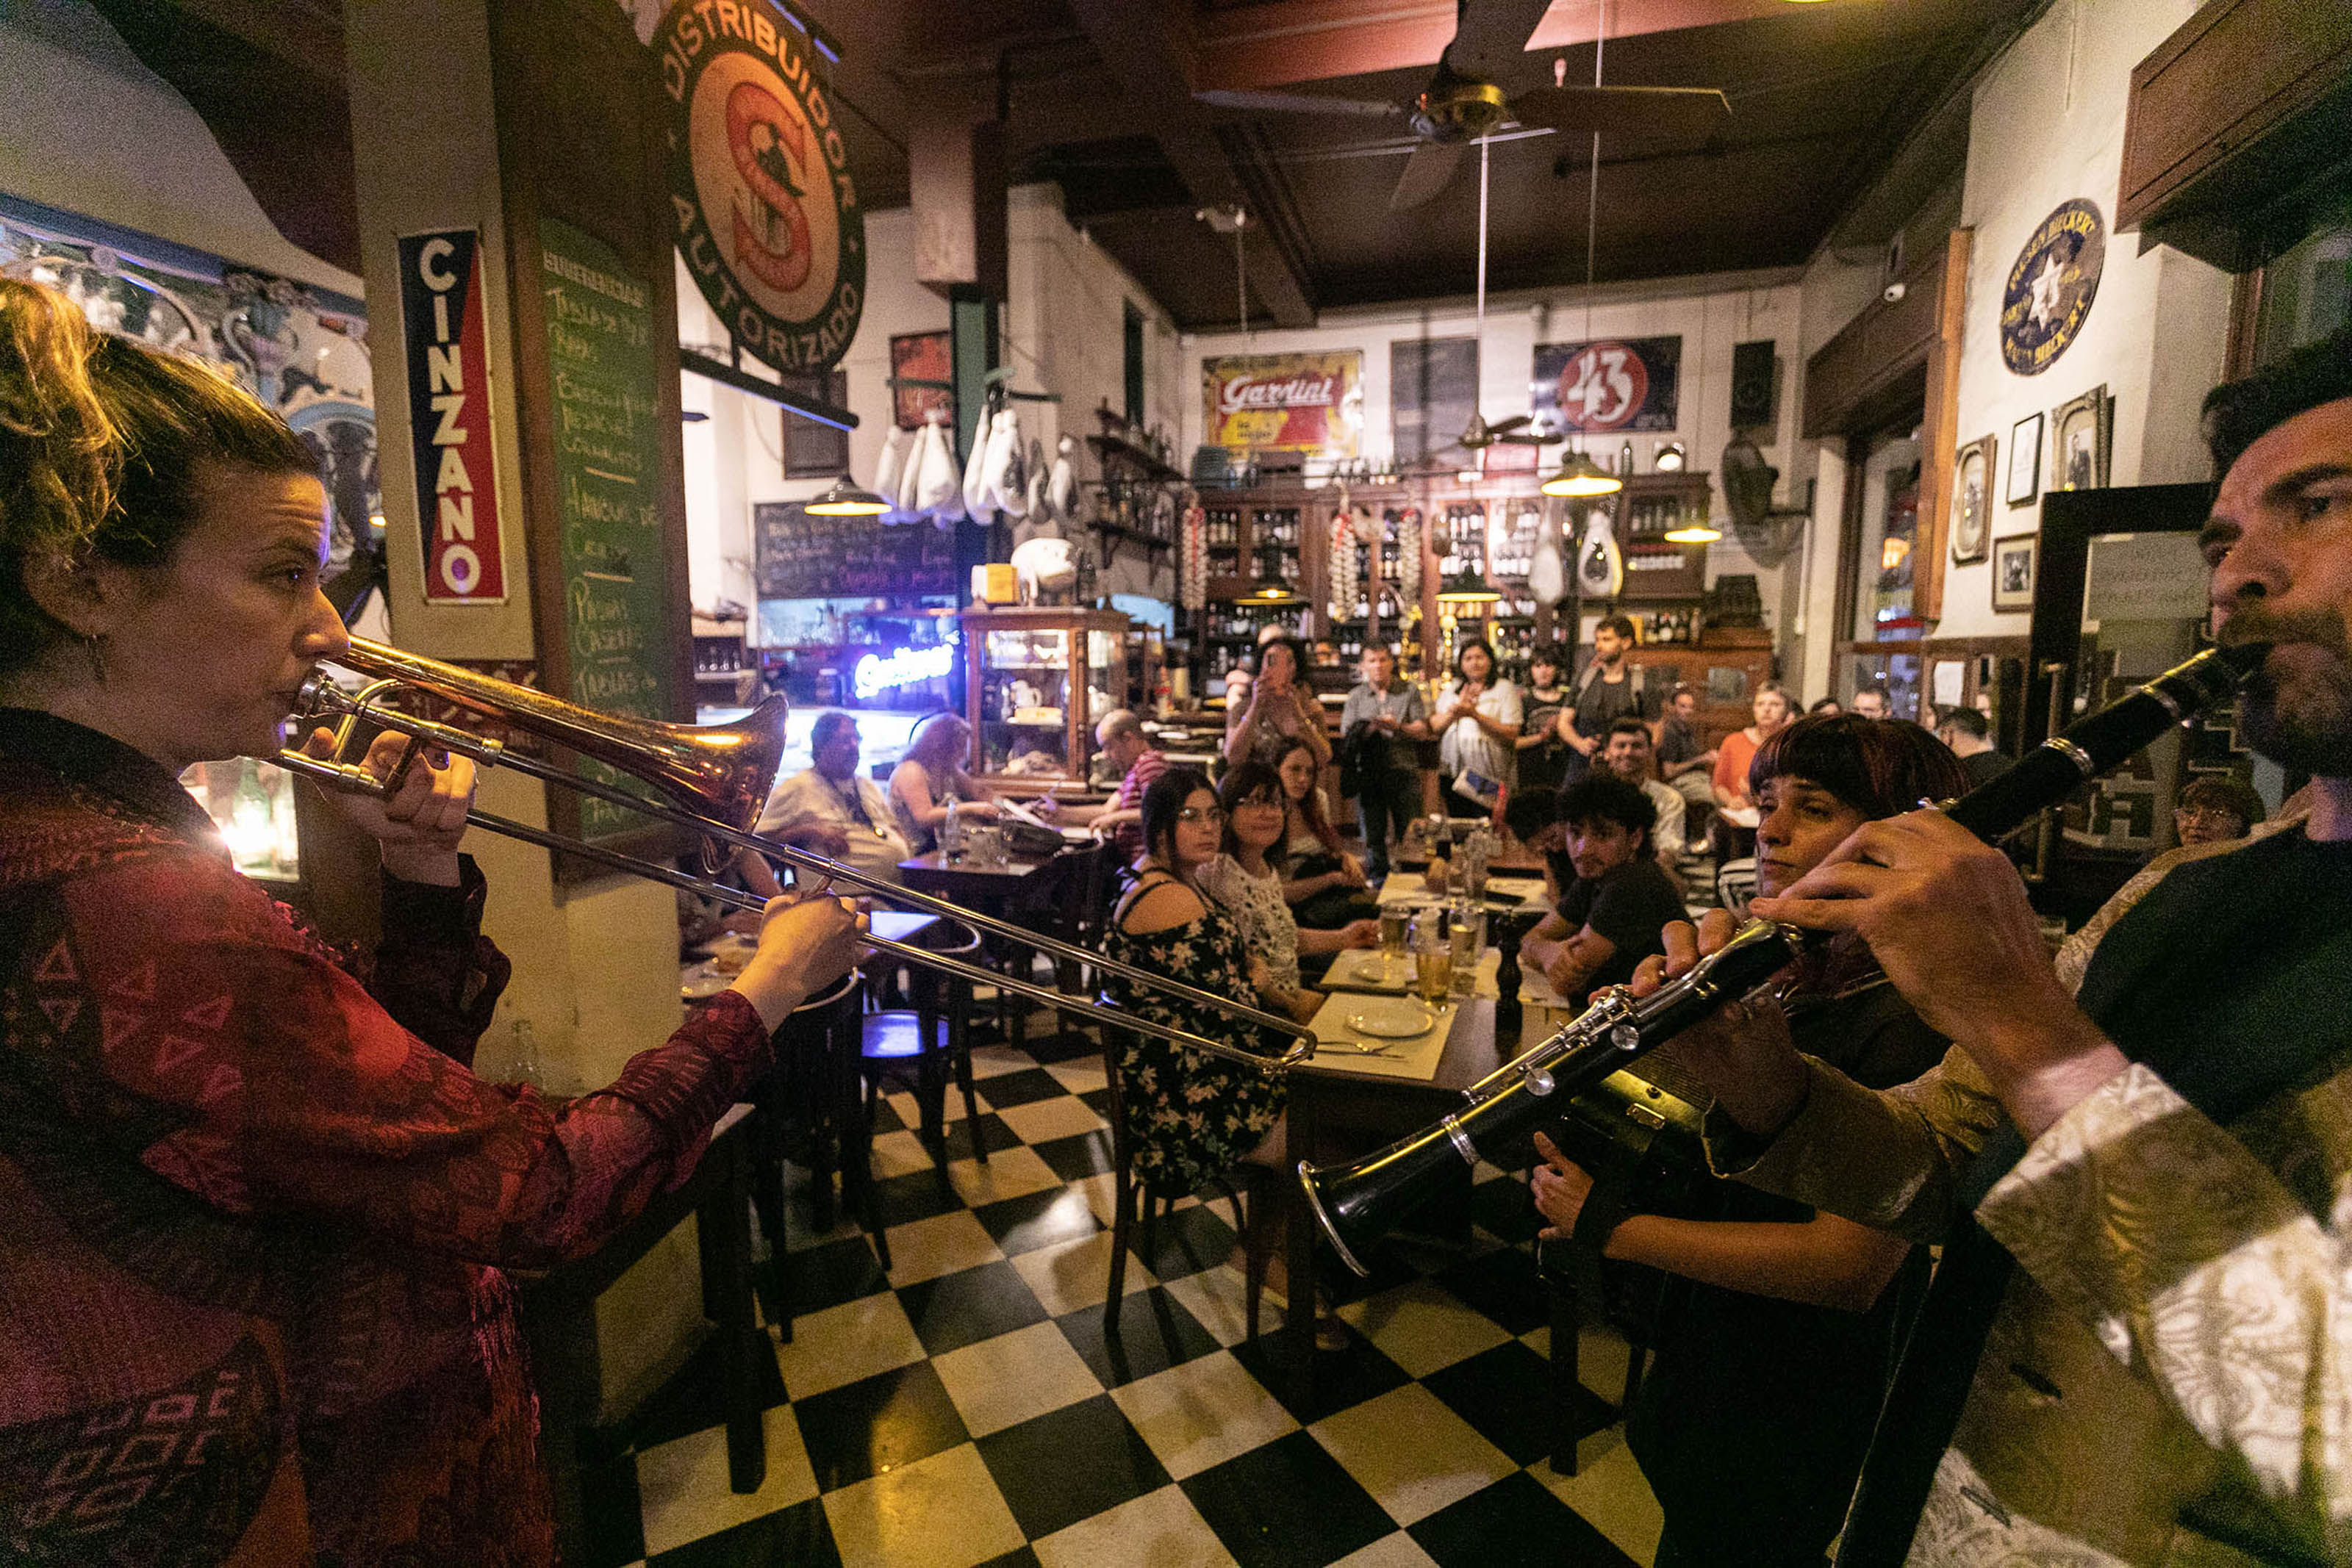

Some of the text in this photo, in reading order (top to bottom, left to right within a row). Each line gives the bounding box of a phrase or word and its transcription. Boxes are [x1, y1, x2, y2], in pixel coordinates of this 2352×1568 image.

[663, 0, 856, 210] DISTRIBUIDOR
[673, 193, 858, 365] AUTORIZADO
[419, 238, 481, 594] CINZANO
[1566, 349, 1633, 423] 43
